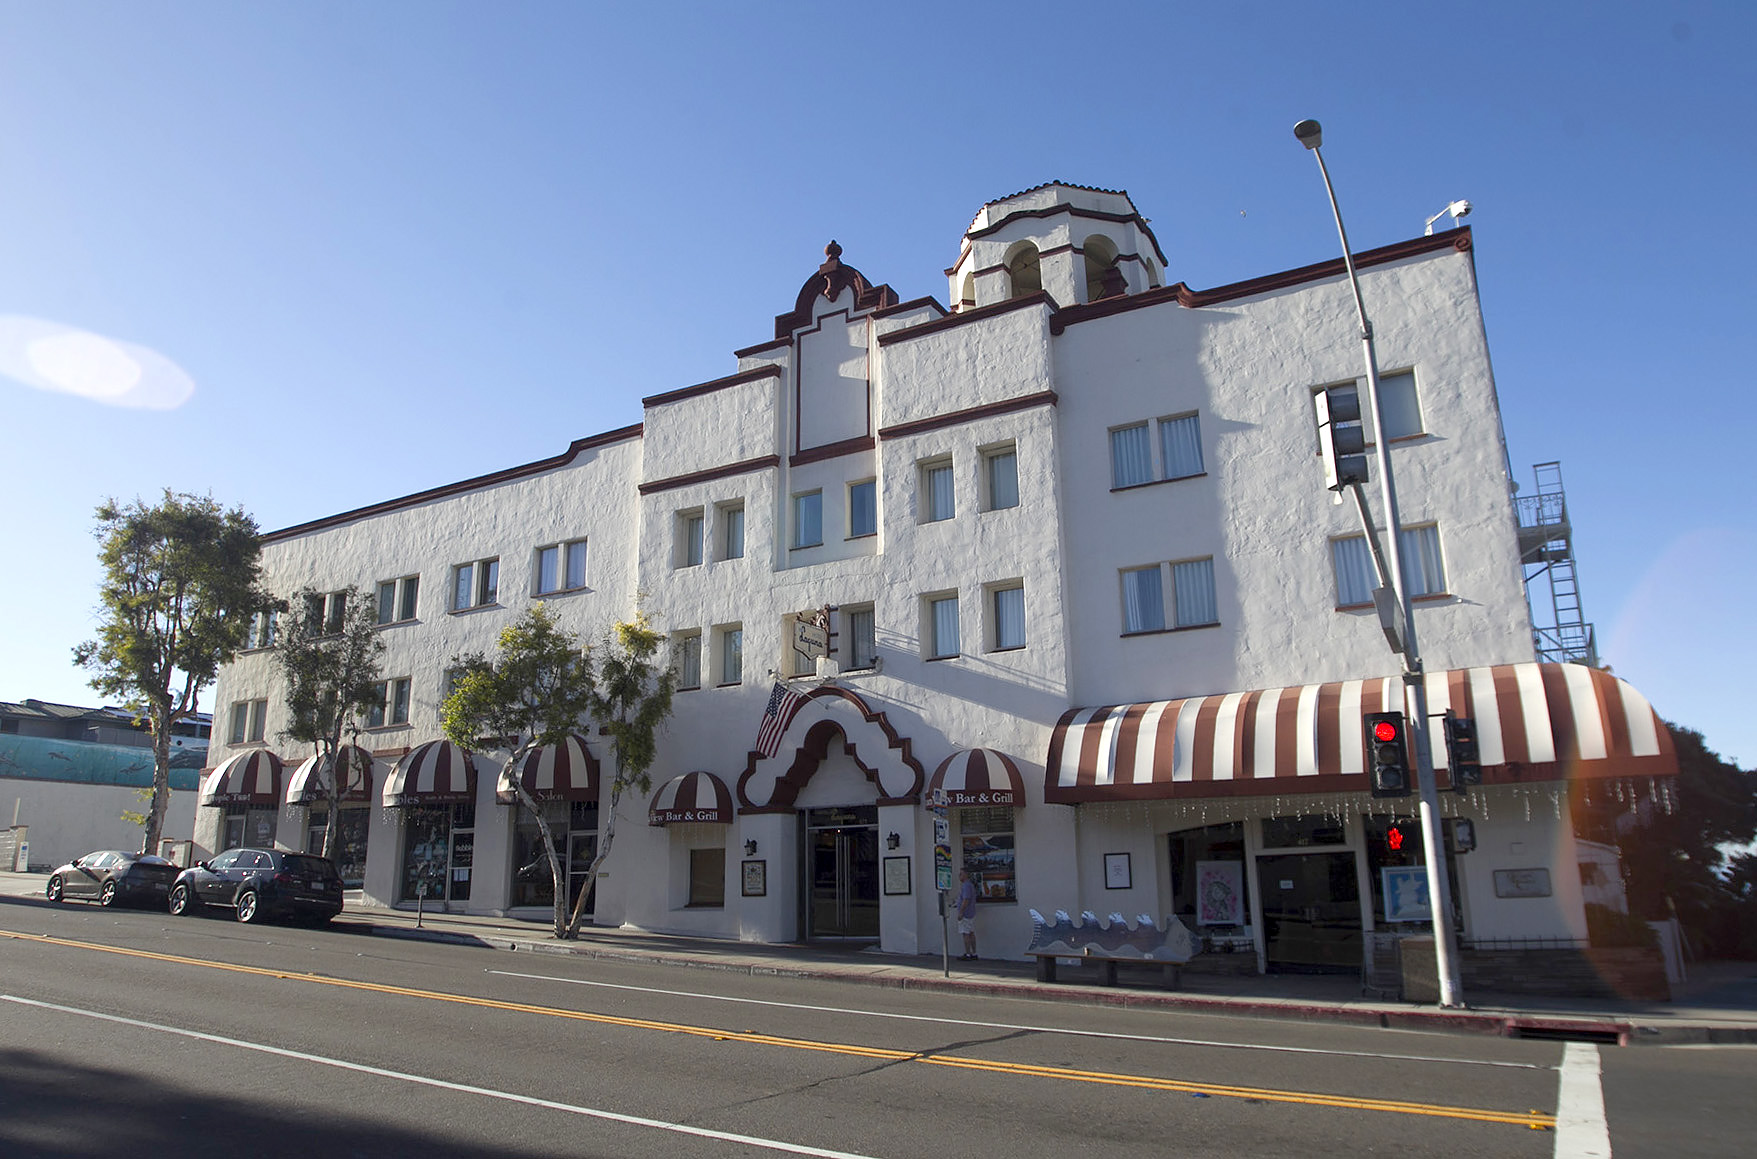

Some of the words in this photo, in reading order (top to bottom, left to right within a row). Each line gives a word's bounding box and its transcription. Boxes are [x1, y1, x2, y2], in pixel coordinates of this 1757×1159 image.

[799, 625, 823, 653] Laguna
[536, 789, 564, 801] Salon
[956, 793, 975, 803] Bar
[978, 793, 989, 803] &
[992, 792, 1013, 803] Grill
[666, 811, 682, 821] Bar
[684, 811, 694, 821] &
[696, 810, 718, 821] Grill
